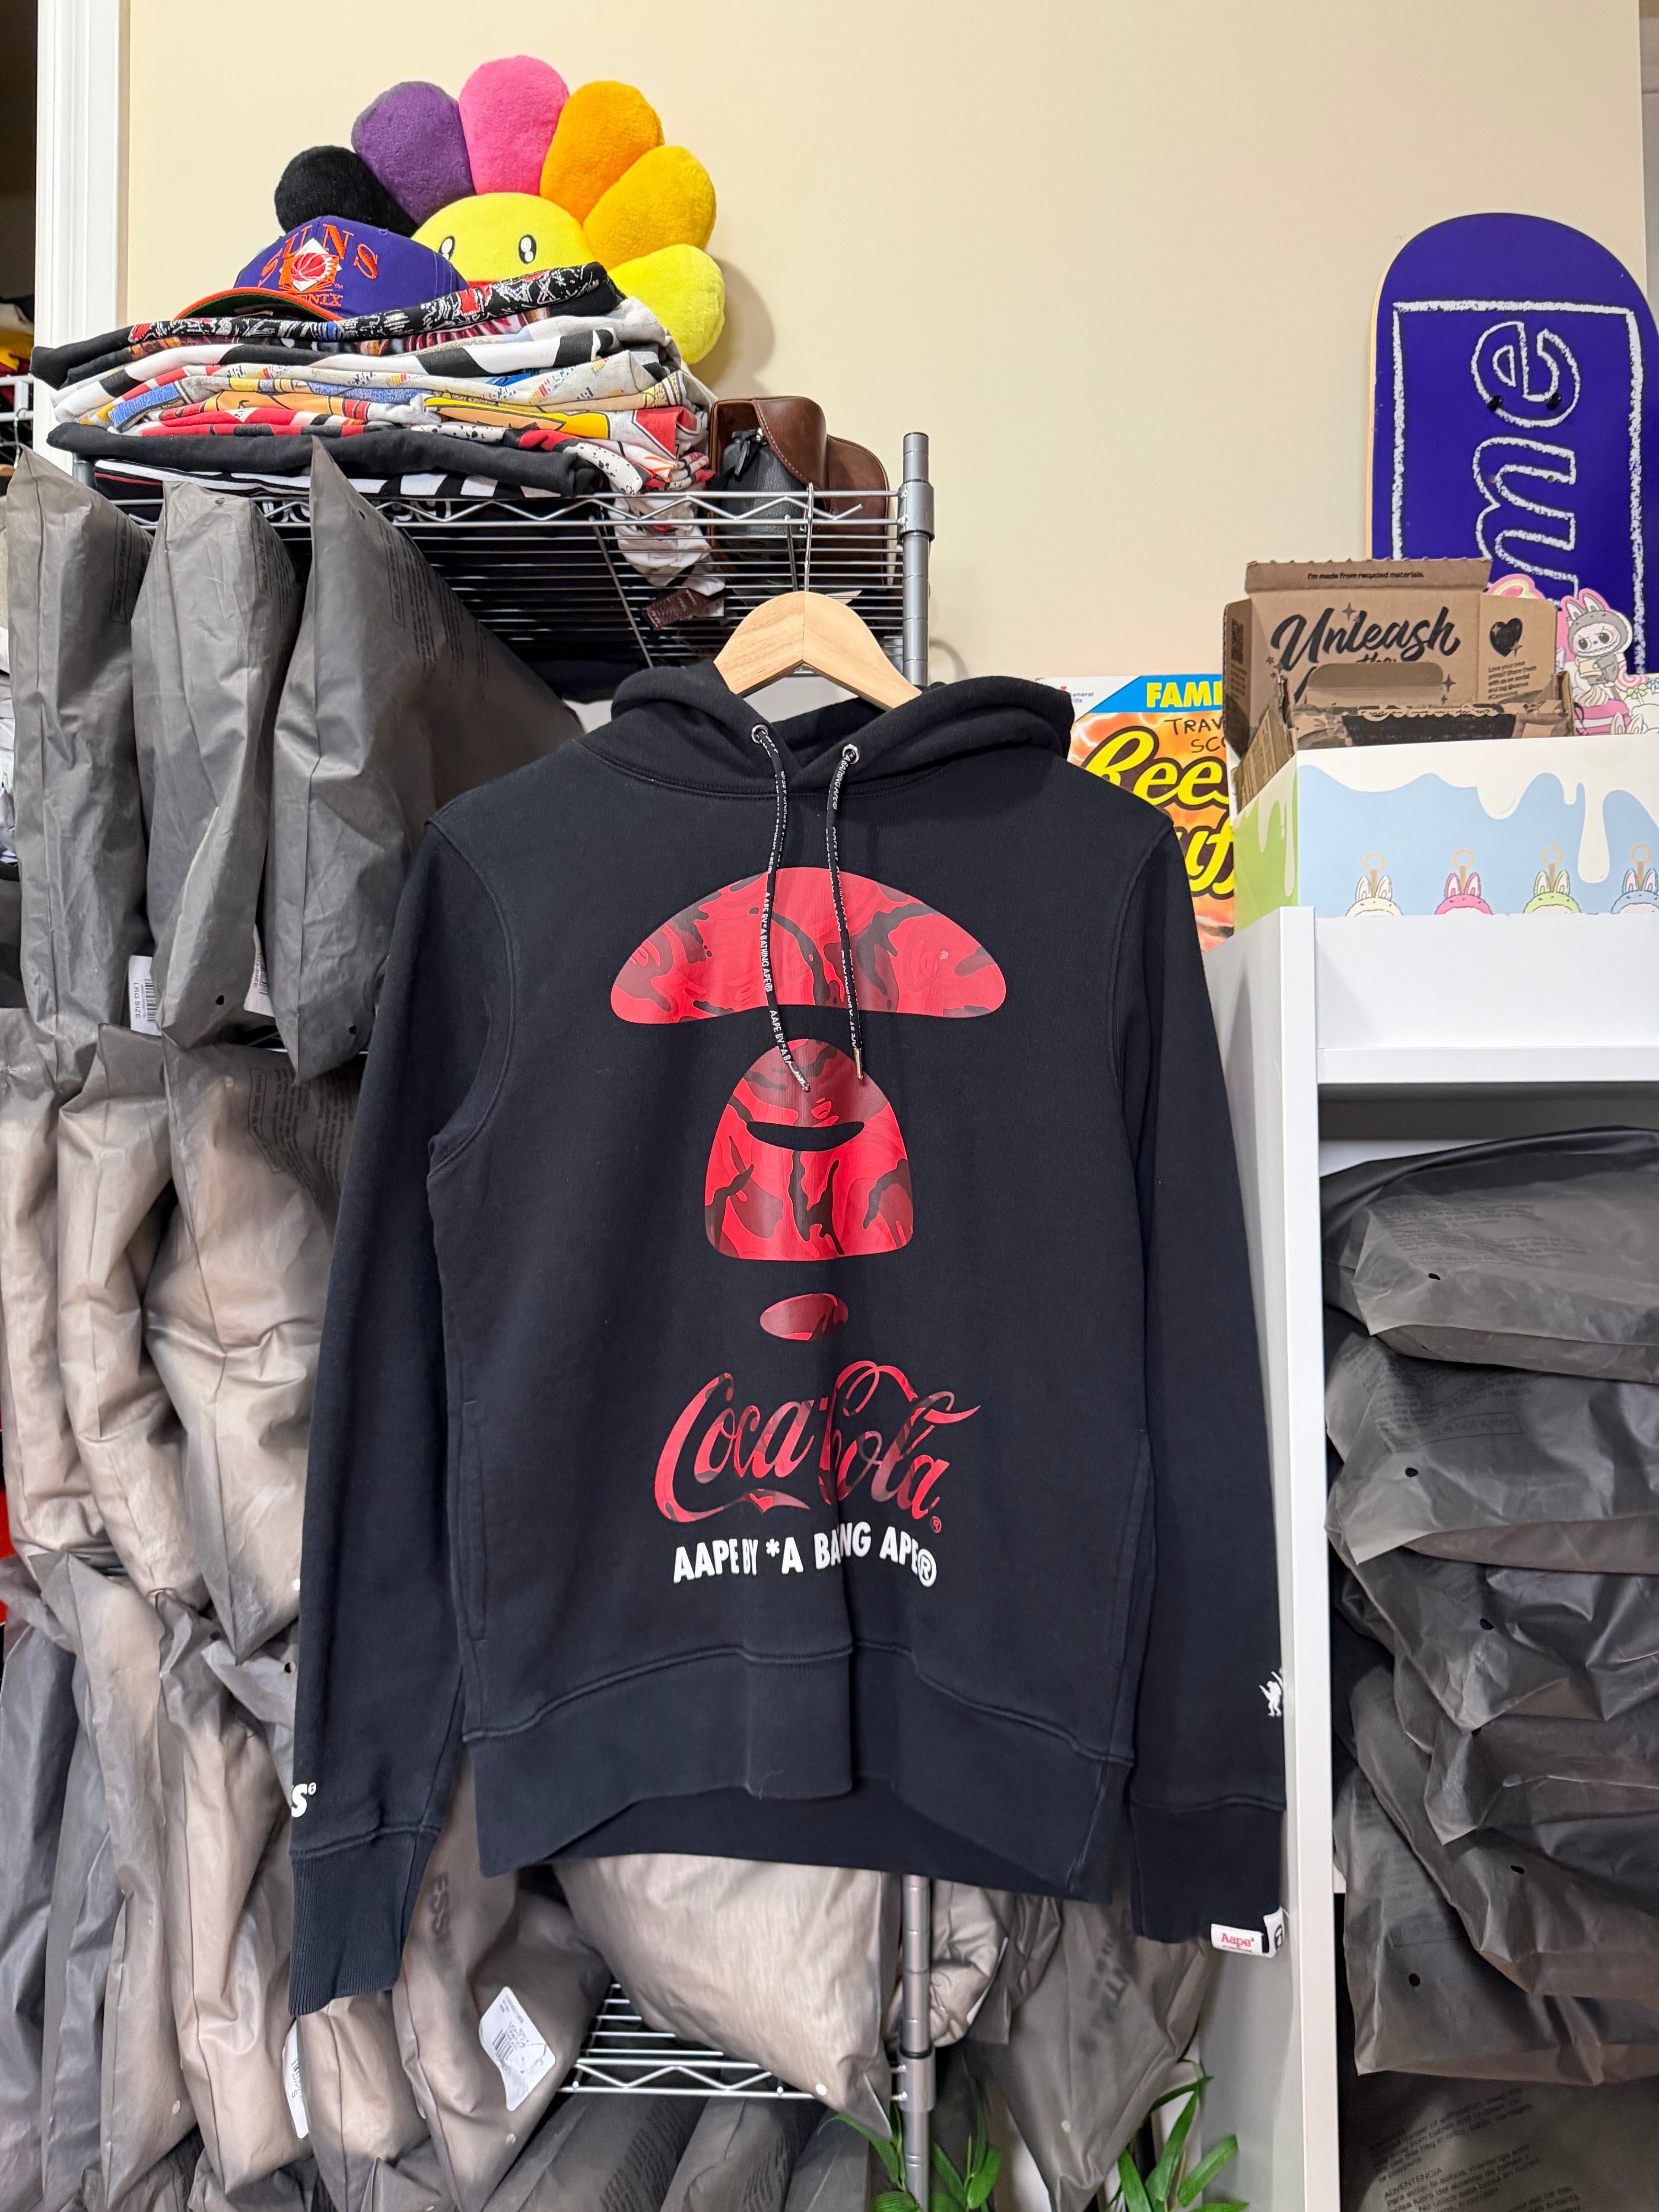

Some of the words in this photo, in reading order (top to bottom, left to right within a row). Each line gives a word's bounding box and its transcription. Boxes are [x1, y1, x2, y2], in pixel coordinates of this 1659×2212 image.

[257, 224, 378, 288] SUNS
[1270, 607, 1460, 672] Unleash
[760, 935, 769, 967] BATHING
[769, 1010, 782, 1033] AAPE
[673, 1538, 739, 1583] AAPE
[741, 1538, 759, 1576] BY
[1221, 1932, 1251, 1948] Aape
